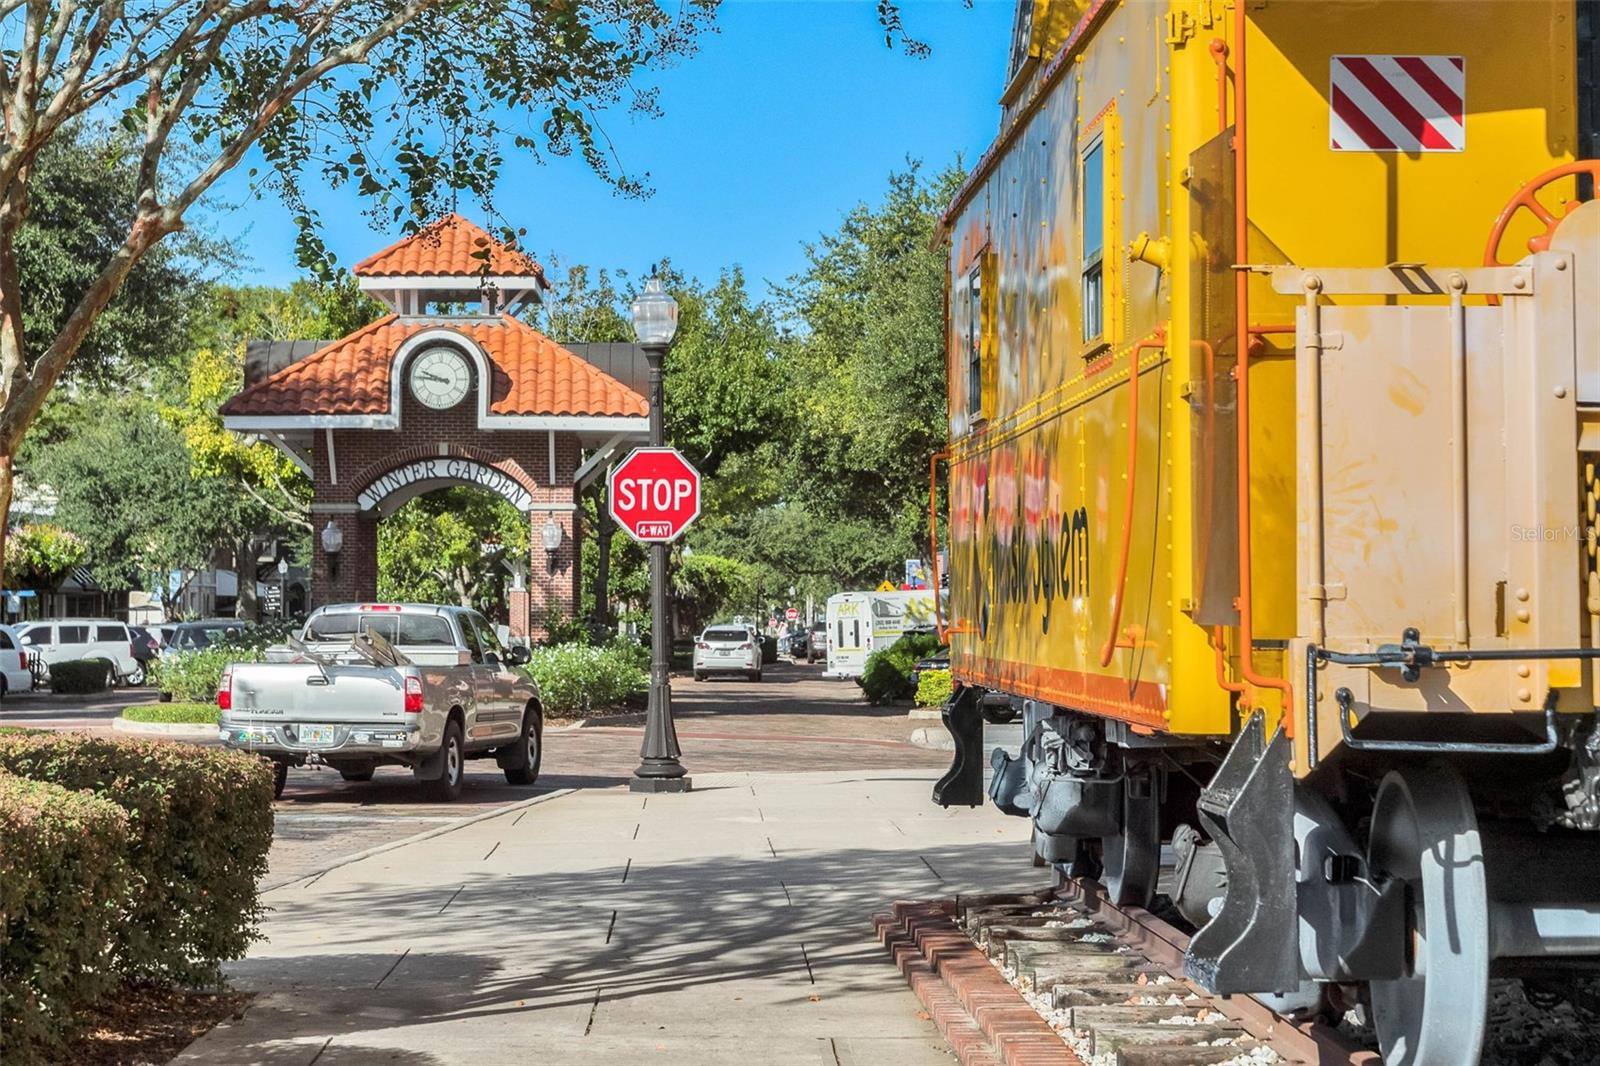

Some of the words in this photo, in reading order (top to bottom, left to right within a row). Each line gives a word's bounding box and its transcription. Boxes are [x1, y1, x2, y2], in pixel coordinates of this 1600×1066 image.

[365, 460, 436, 502] WINTER
[447, 459, 526, 504] GARDEN
[618, 478, 692, 511] STOP
[639, 525, 669, 536] 4-WAY
